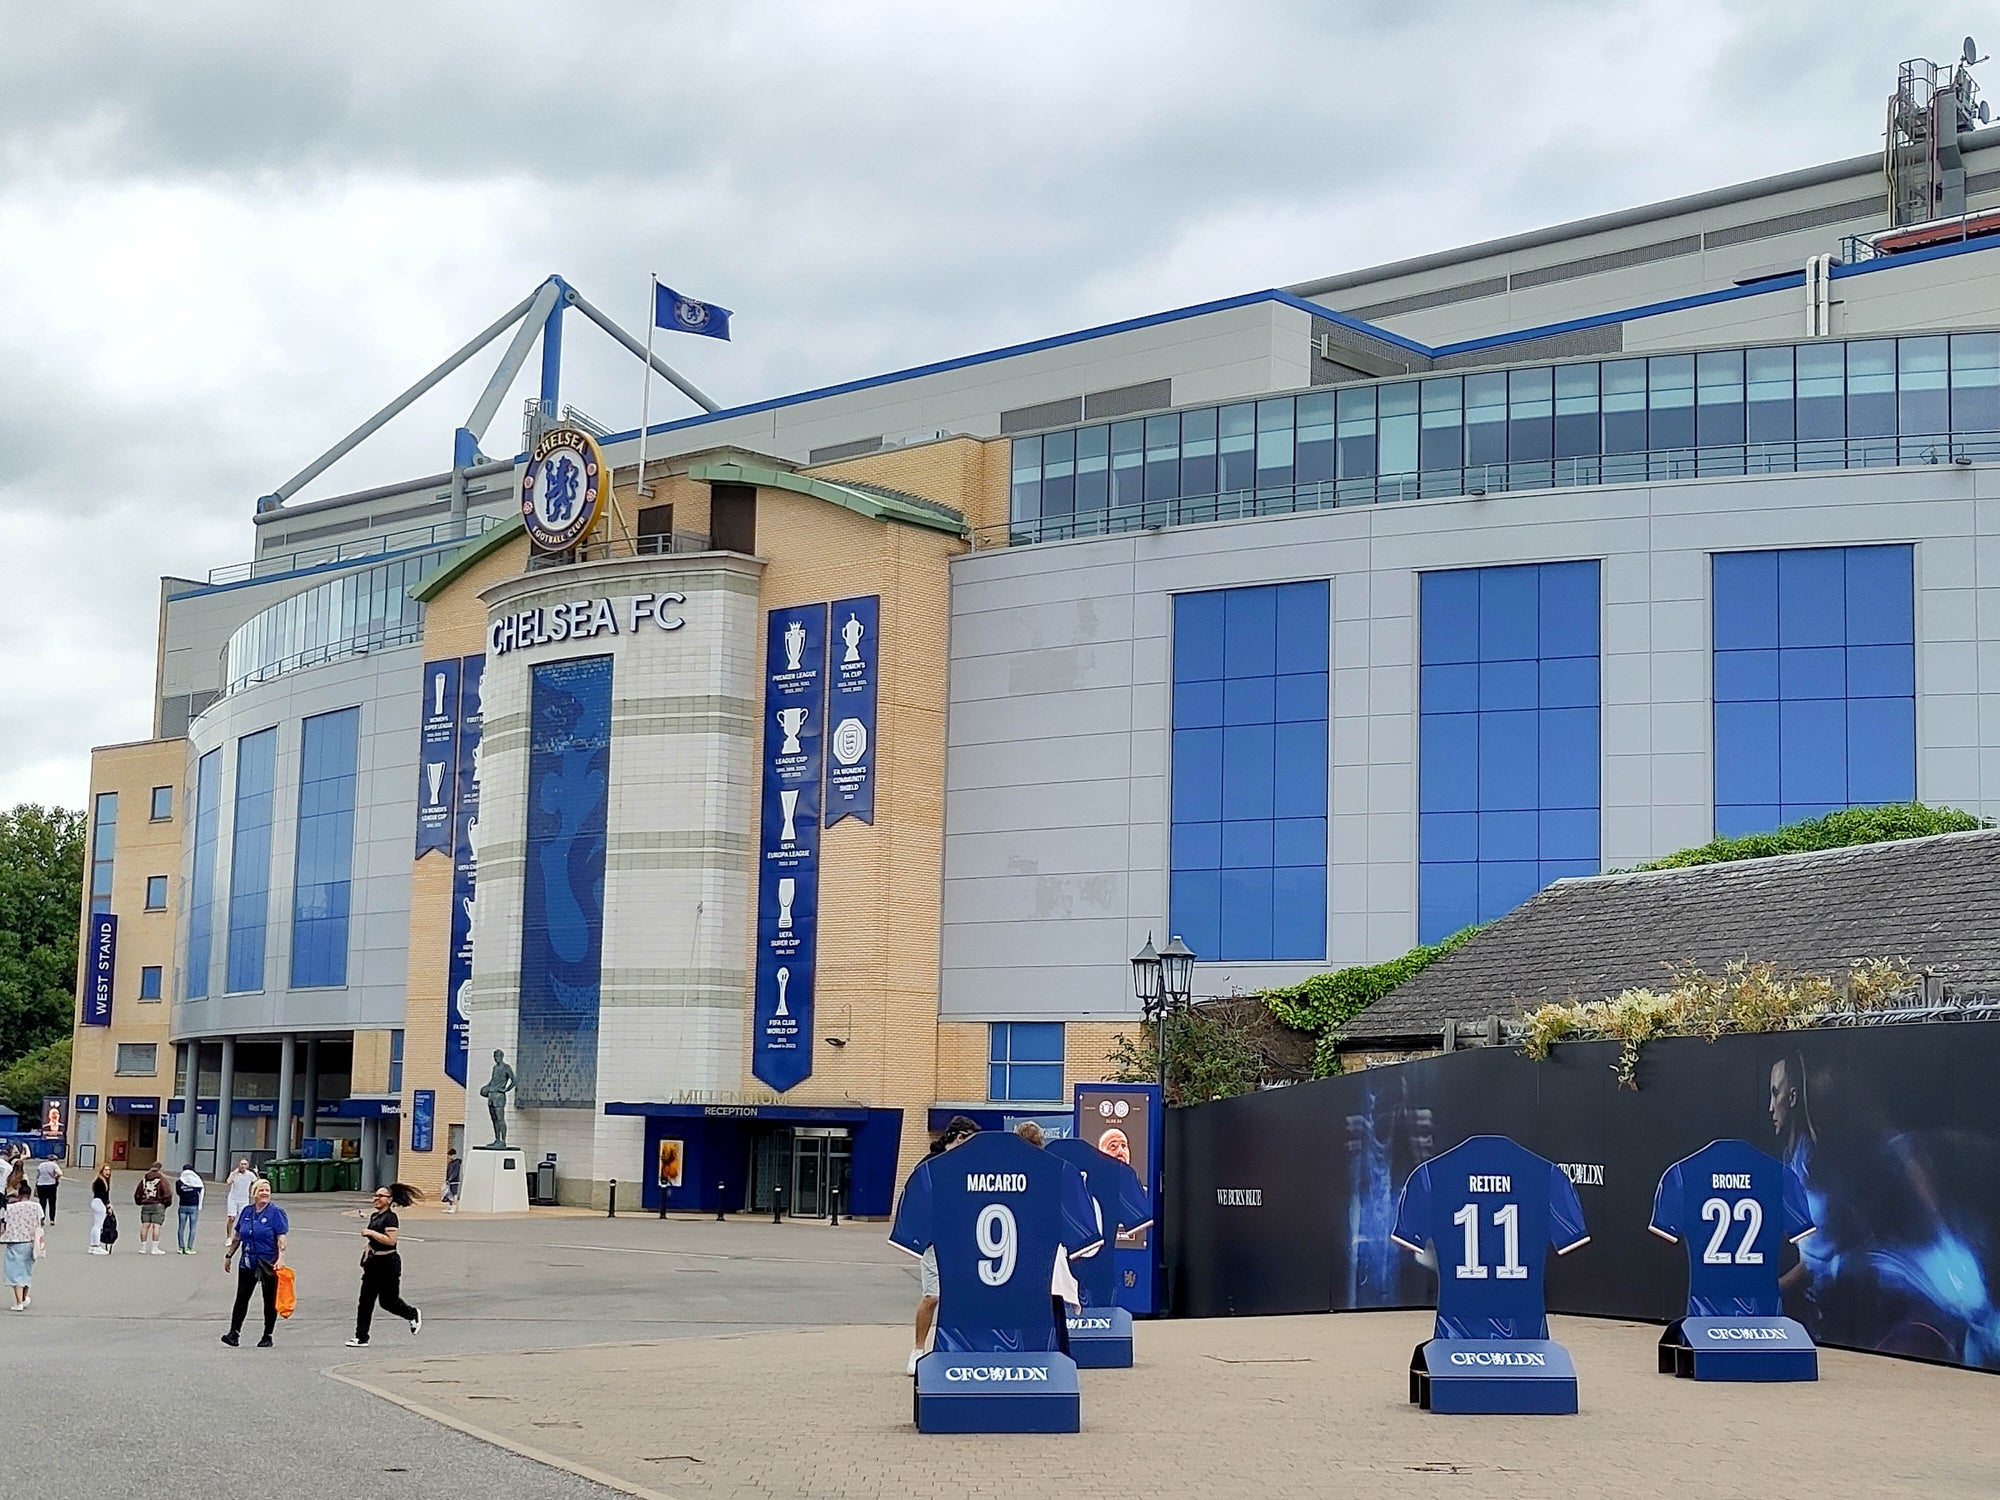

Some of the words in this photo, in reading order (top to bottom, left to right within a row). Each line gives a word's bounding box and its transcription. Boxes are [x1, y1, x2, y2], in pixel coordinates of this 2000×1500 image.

[534, 432, 585, 461] CHELSEA
[532, 525, 564, 543] FOOTBALL
[568, 516, 585, 537] CLUB
[491, 598, 618, 655] CHELSEA
[630, 592, 686, 632] FC
[772, 673, 795, 682] PREMIER
[796, 670, 817, 679] LEAGUE
[98, 923, 112, 970] STAND
[96, 975, 108, 1015] WEST
[679, 1089, 788, 1106] MILLENNIUM
[704, 1106, 758, 1116] RECEPTION
[967, 1174, 1026, 1192] MACARIO
[1469, 1176, 1510, 1192] REITEN
[1712, 1174, 1751, 1189] BRONZE
[976, 1203, 1018, 1287] 9
[1454, 1203, 1528, 1279] 11
[1702, 1198, 1764, 1264] 22
